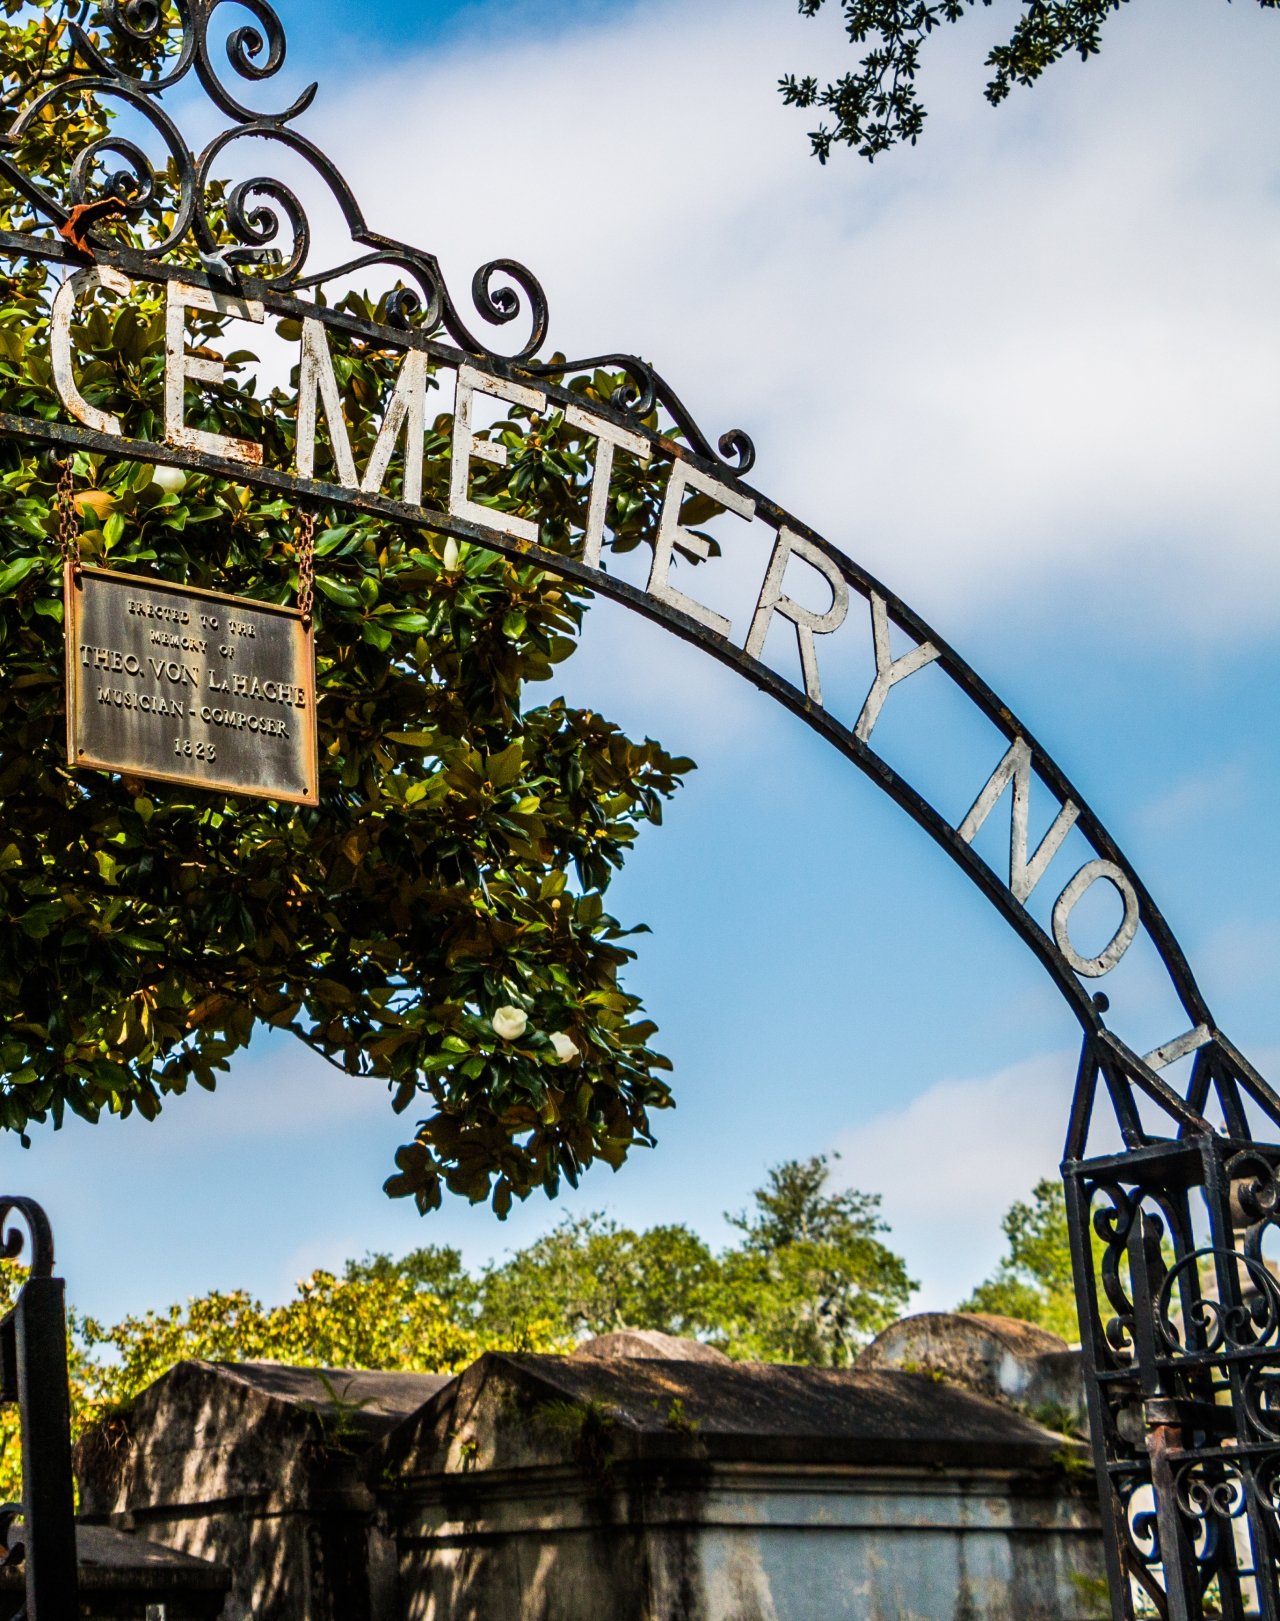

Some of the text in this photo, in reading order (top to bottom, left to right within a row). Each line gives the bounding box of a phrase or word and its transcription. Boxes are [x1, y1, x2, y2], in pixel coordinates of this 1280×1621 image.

[50, 264, 939, 744] CEMETERY
[128, 601, 257, 639] ERECTED TO THE
[80, 645, 144, 678] THEO.
[148, 657, 200, 688] VON
[150, 630, 235, 660] MEMORY OF
[97, 687, 184, 718] MUSICIAN
[200, 706, 290, 740] COMPOSER
